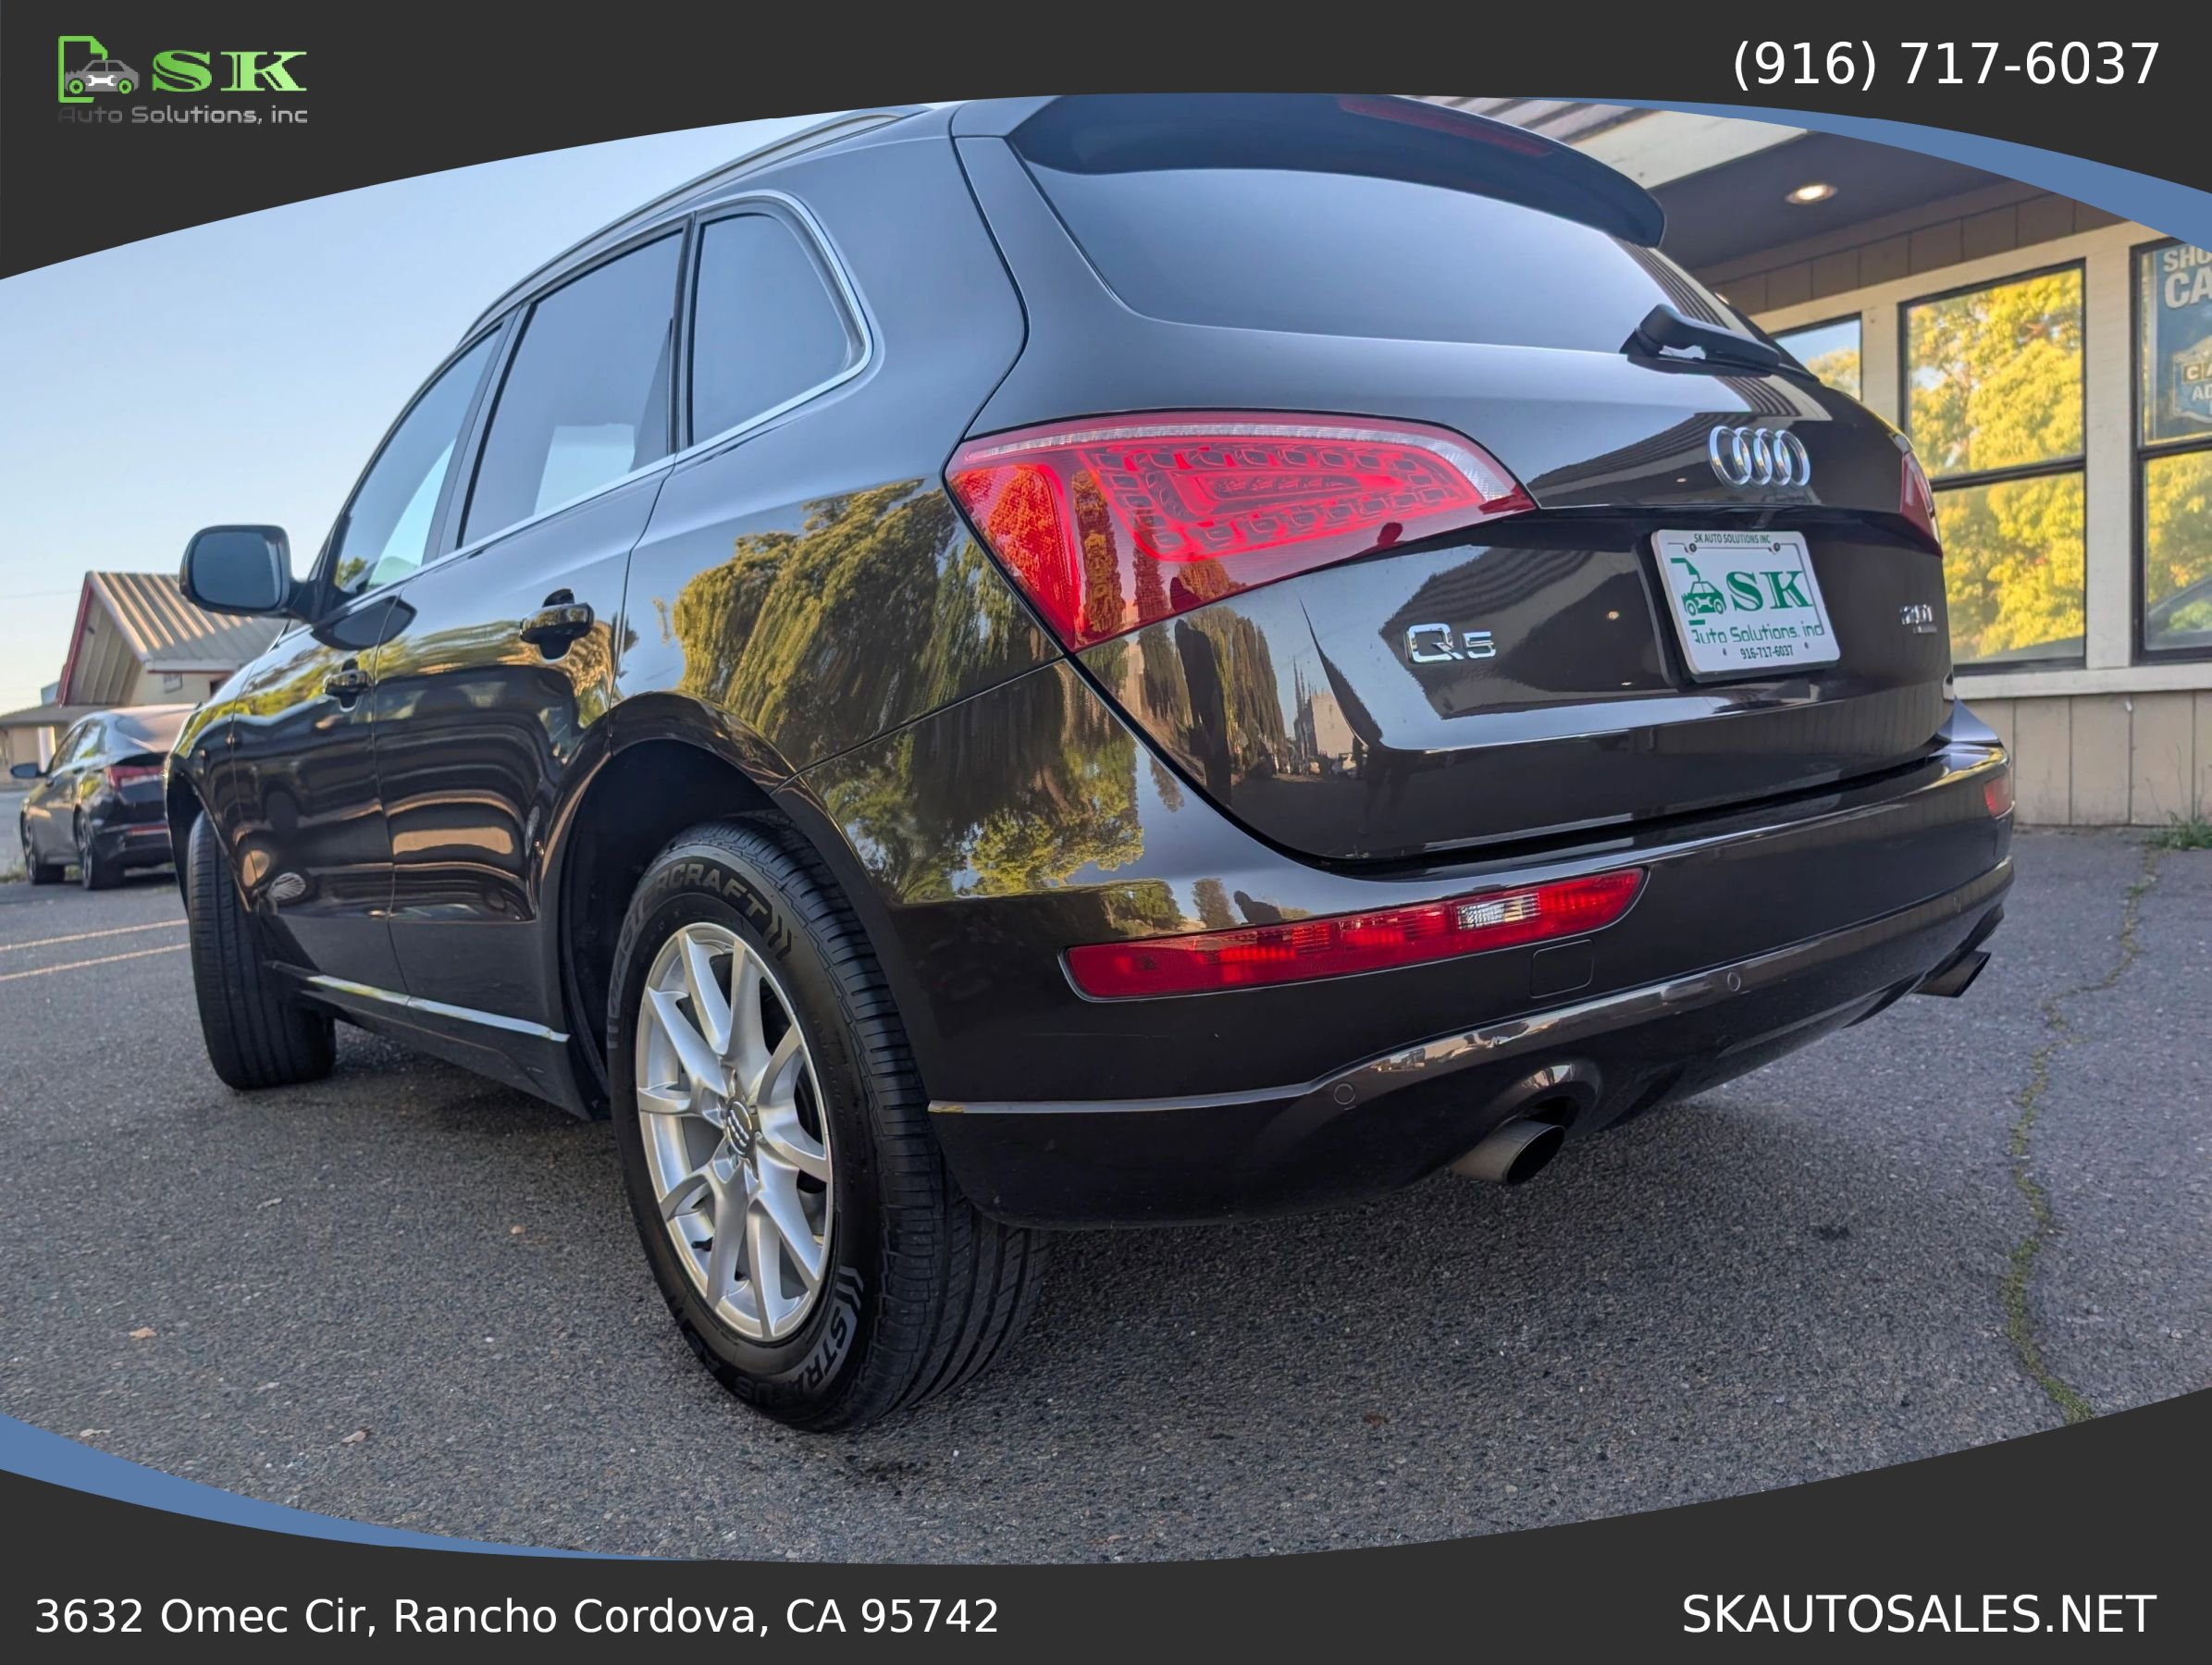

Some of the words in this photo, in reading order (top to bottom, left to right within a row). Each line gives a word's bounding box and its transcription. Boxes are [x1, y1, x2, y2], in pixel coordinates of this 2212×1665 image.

[1694, 533, 1703, 543] SK
[1704, 533, 1723, 544] AUTO
[1724, 533, 1760, 544] SOLUTIONS
[1760, 534, 1771, 544] INC
[1726, 571, 1814, 611] SK
[1404, 623, 1497, 664] Q5
[1739, 645, 1794, 660] 916-717-6037
